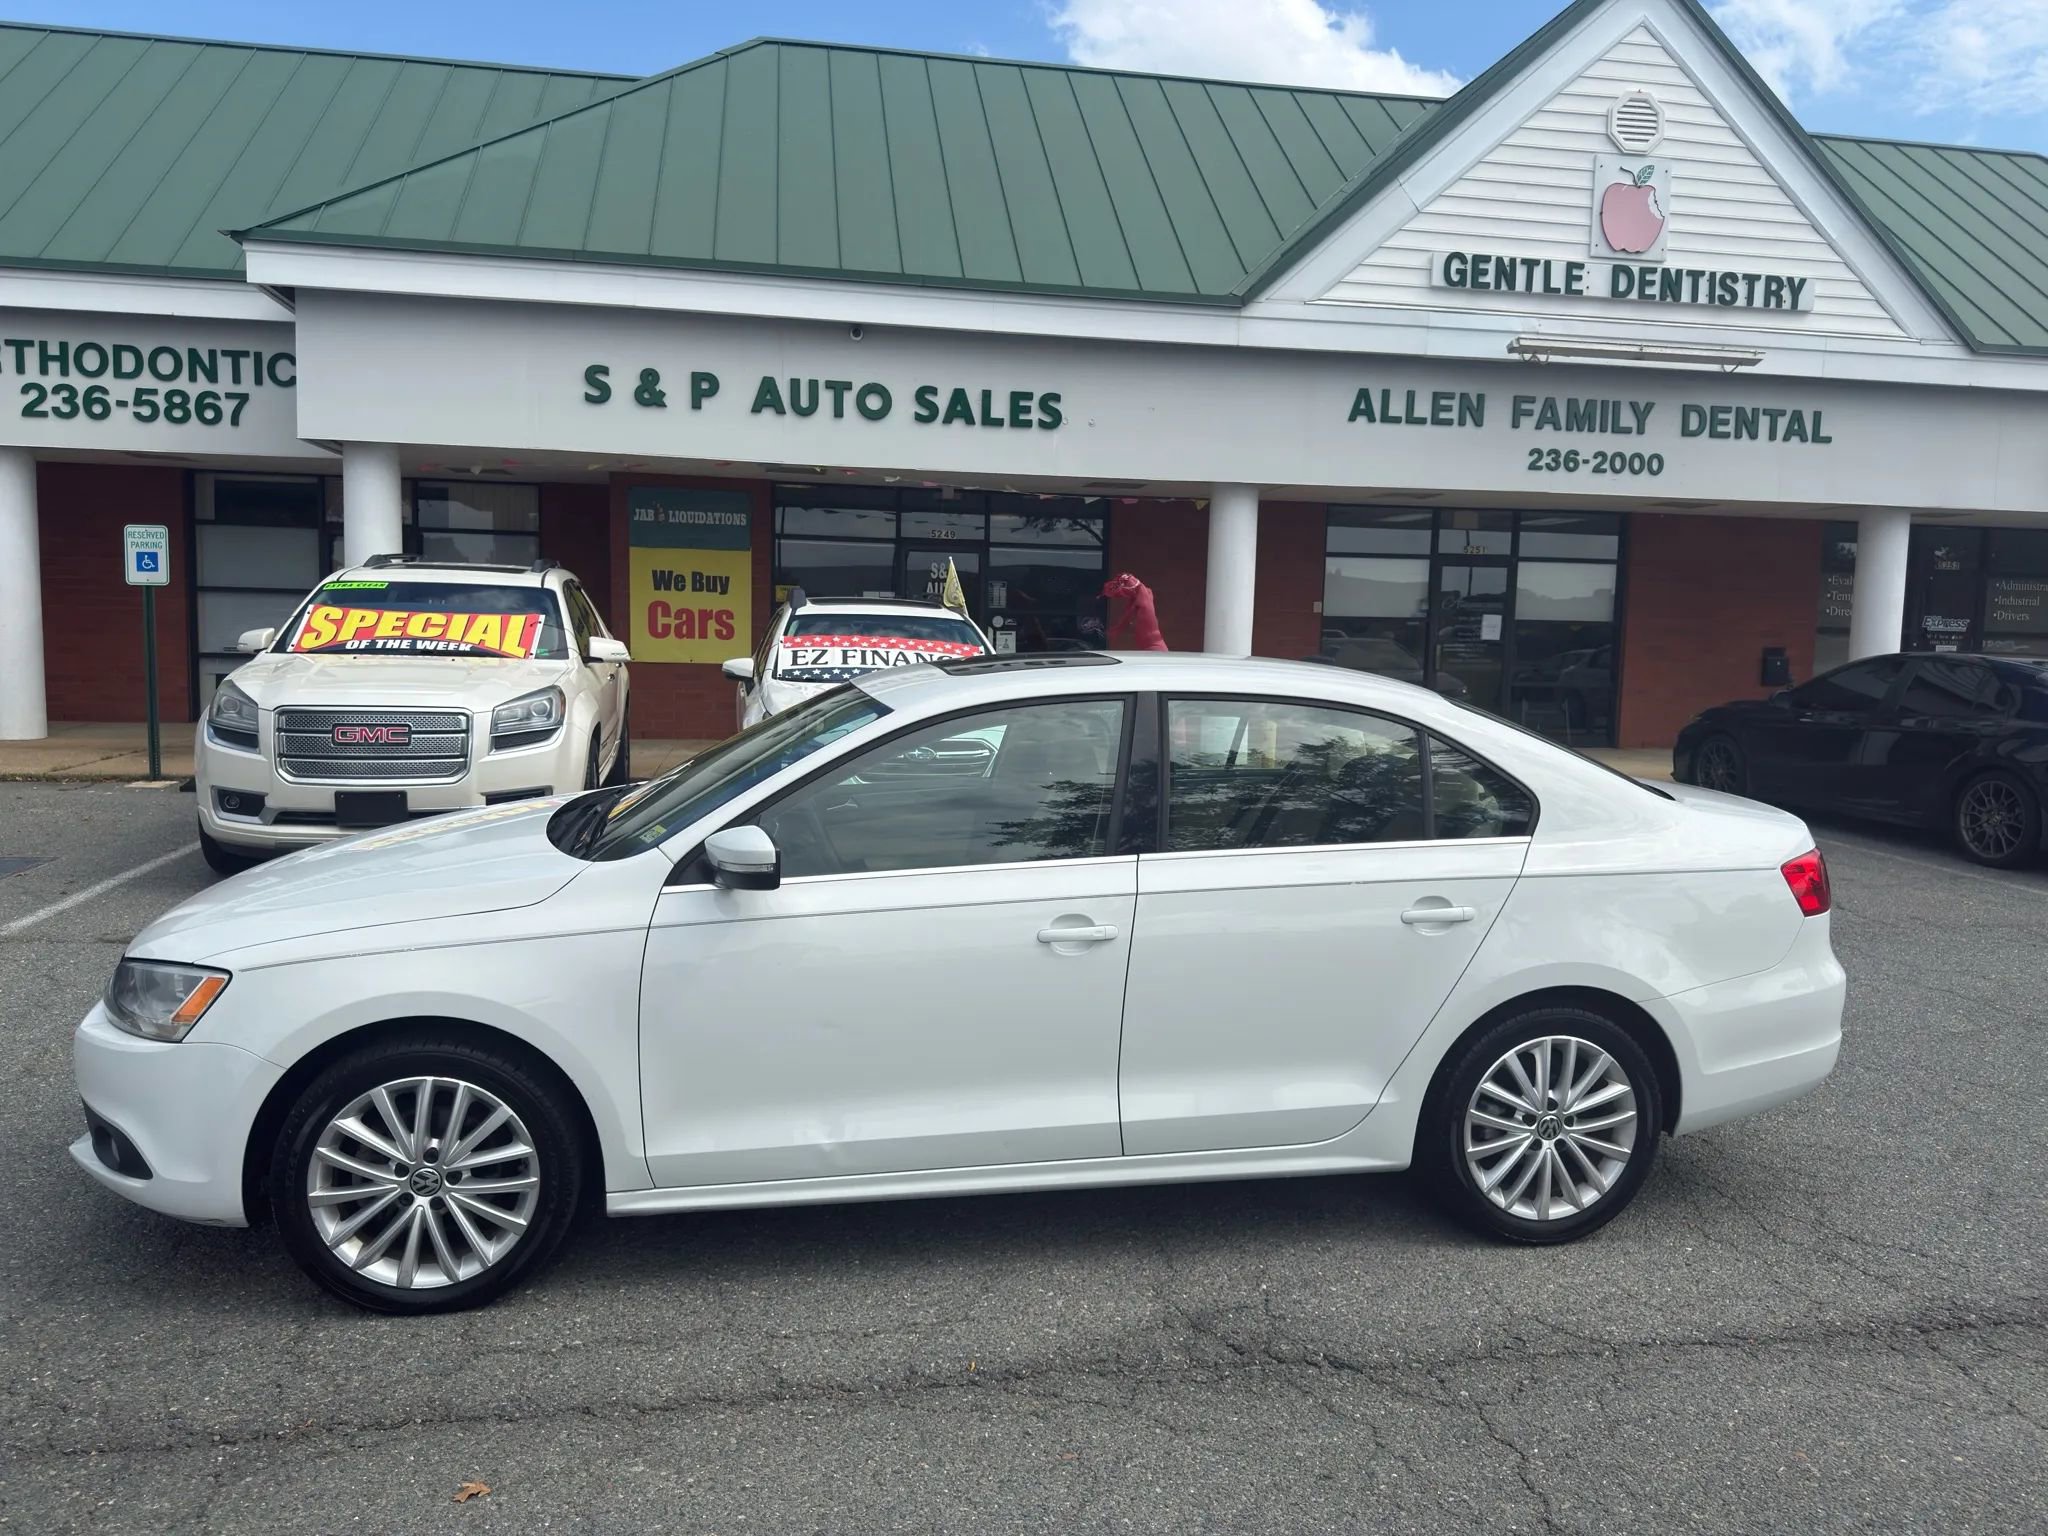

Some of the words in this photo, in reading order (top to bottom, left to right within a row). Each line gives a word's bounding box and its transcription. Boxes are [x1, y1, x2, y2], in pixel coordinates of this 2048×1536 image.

[1443, 251, 1586, 296] GENTLE
[1611, 263, 1808, 311] DENTISTRY
[0, 338, 297, 388] THODONTIC
[20, 382, 250, 427] 236-5867
[584, 364, 612, 404] S
[634, 367, 667, 408] &
[690, 371, 720, 410] P
[751, 376, 893, 421] AUTO
[914, 385, 1064, 430] SALES
[1347, 387, 1486, 428] ALLEN
[1511, 394, 1656, 435] FAMILY
[1680, 403, 1833, 444] DENTAL
[1527, 447, 1665, 477] 236-2000
[633, 508, 655, 521] JAB
[668, 510, 747, 526] LIQUIDATIONS
[127, 530, 165, 540] RESERVED
[931, 529, 956, 539] 5249
[131, 541, 163, 549] PARKING
[1463, 545, 1486, 554] 5251
[651, 569, 686, 592] We
[691, 571, 730, 595] Buy
[1998, 596, 2040, 607] Industrial
[647, 600, 736, 641] Cars
[1997, 610, 2031, 621] Drivers
[300, 606, 529, 659] SPECIAL
[345, 639, 371, 650] OF
[375, 639, 411, 650] THE
[416, 640, 473, 652] WEEK
[790, 649, 829, 667] EZ
[334, 726, 409, 743] GMC
